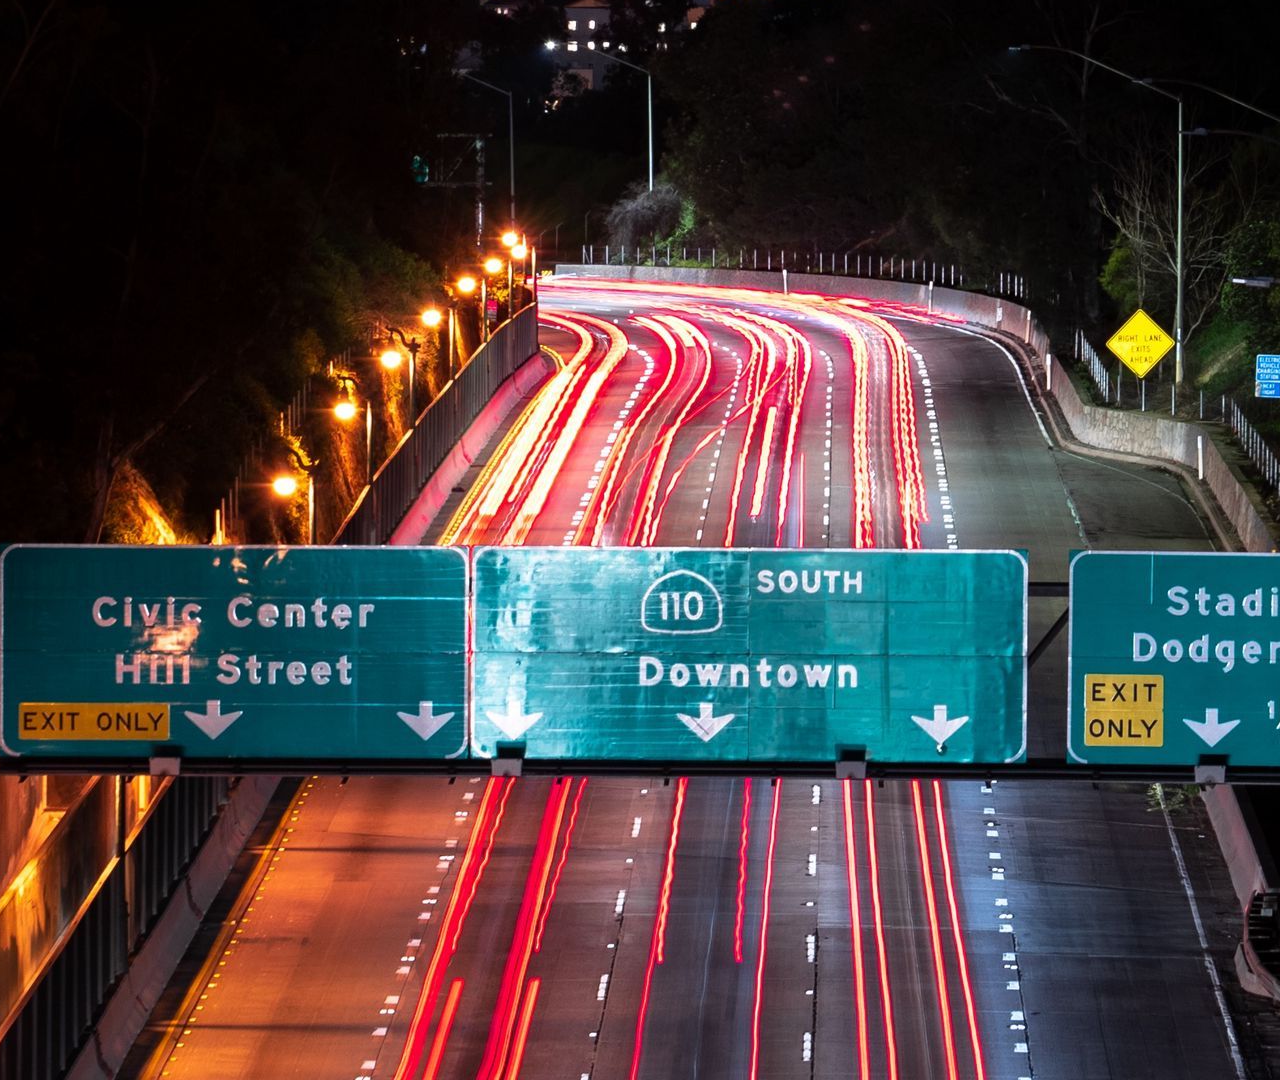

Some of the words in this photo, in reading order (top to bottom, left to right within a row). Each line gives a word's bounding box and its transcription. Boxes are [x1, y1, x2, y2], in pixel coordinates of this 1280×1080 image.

[757, 570, 862, 594] SOUTH
[92, 596, 202, 627] Civic
[227, 596, 375, 628] Center
[659, 591, 703, 620] 110
[115, 653, 191, 684] Hill
[216, 653, 353, 685] Street
[639, 656, 858, 688] Downtown
[1091, 683, 1157, 702] EXIT
[23, 712, 80, 731] EXIT
[96, 712, 164, 732] ONLY
[1089, 719, 1158, 738] ONLY
